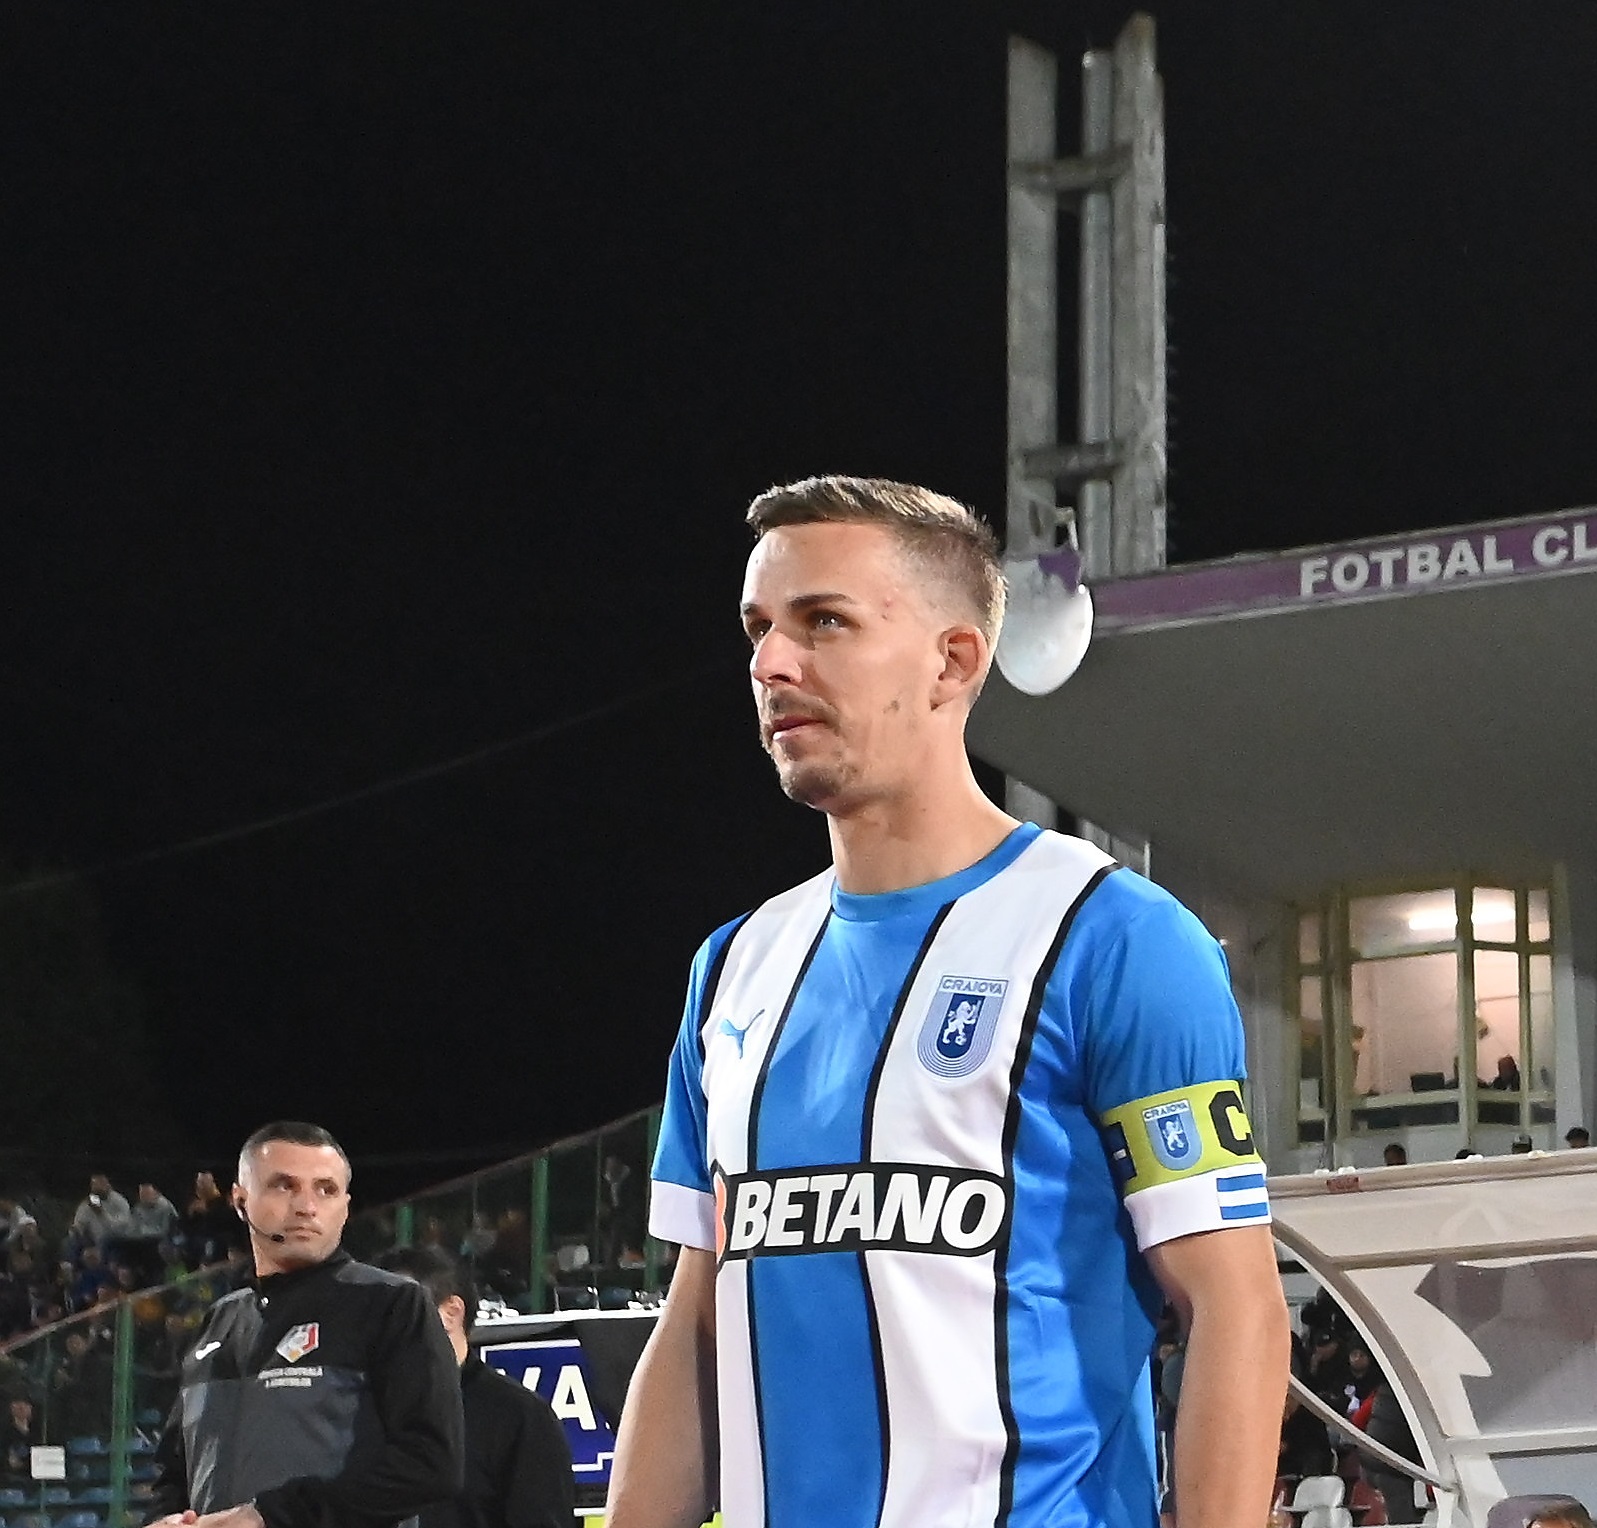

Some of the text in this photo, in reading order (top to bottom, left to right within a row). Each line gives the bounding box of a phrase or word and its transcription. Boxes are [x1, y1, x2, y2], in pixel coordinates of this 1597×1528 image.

[1300, 536, 1514, 597] FOTBAL
[942, 979, 1003, 995] CRAIOVA
[1144, 1103, 1188, 1120] CRAIOVA
[1208, 1090, 1255, 1157] C
[730, 1172, 1008, 1252] BETANO
